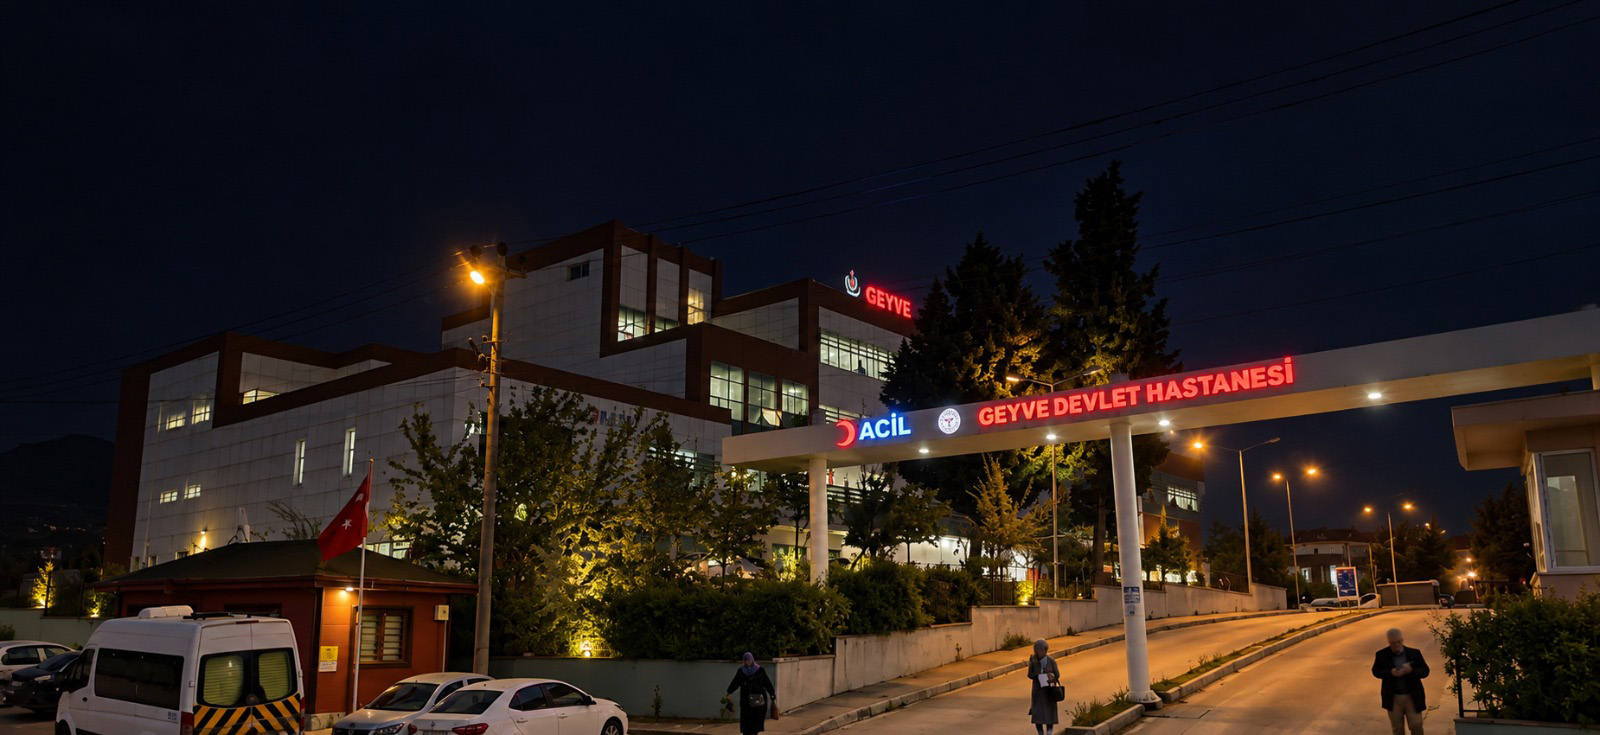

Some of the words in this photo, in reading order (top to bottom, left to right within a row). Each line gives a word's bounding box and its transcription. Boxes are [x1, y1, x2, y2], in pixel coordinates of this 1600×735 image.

[865, 286, 912, 319] GEYVE
[978, 399, 1050, 426] GEYVE
[1054, 385, 1141, 416] DEVLET
[1146, 356, 1294, 403] HASTANESİ
[859, 412, 911, 440] ACİL
